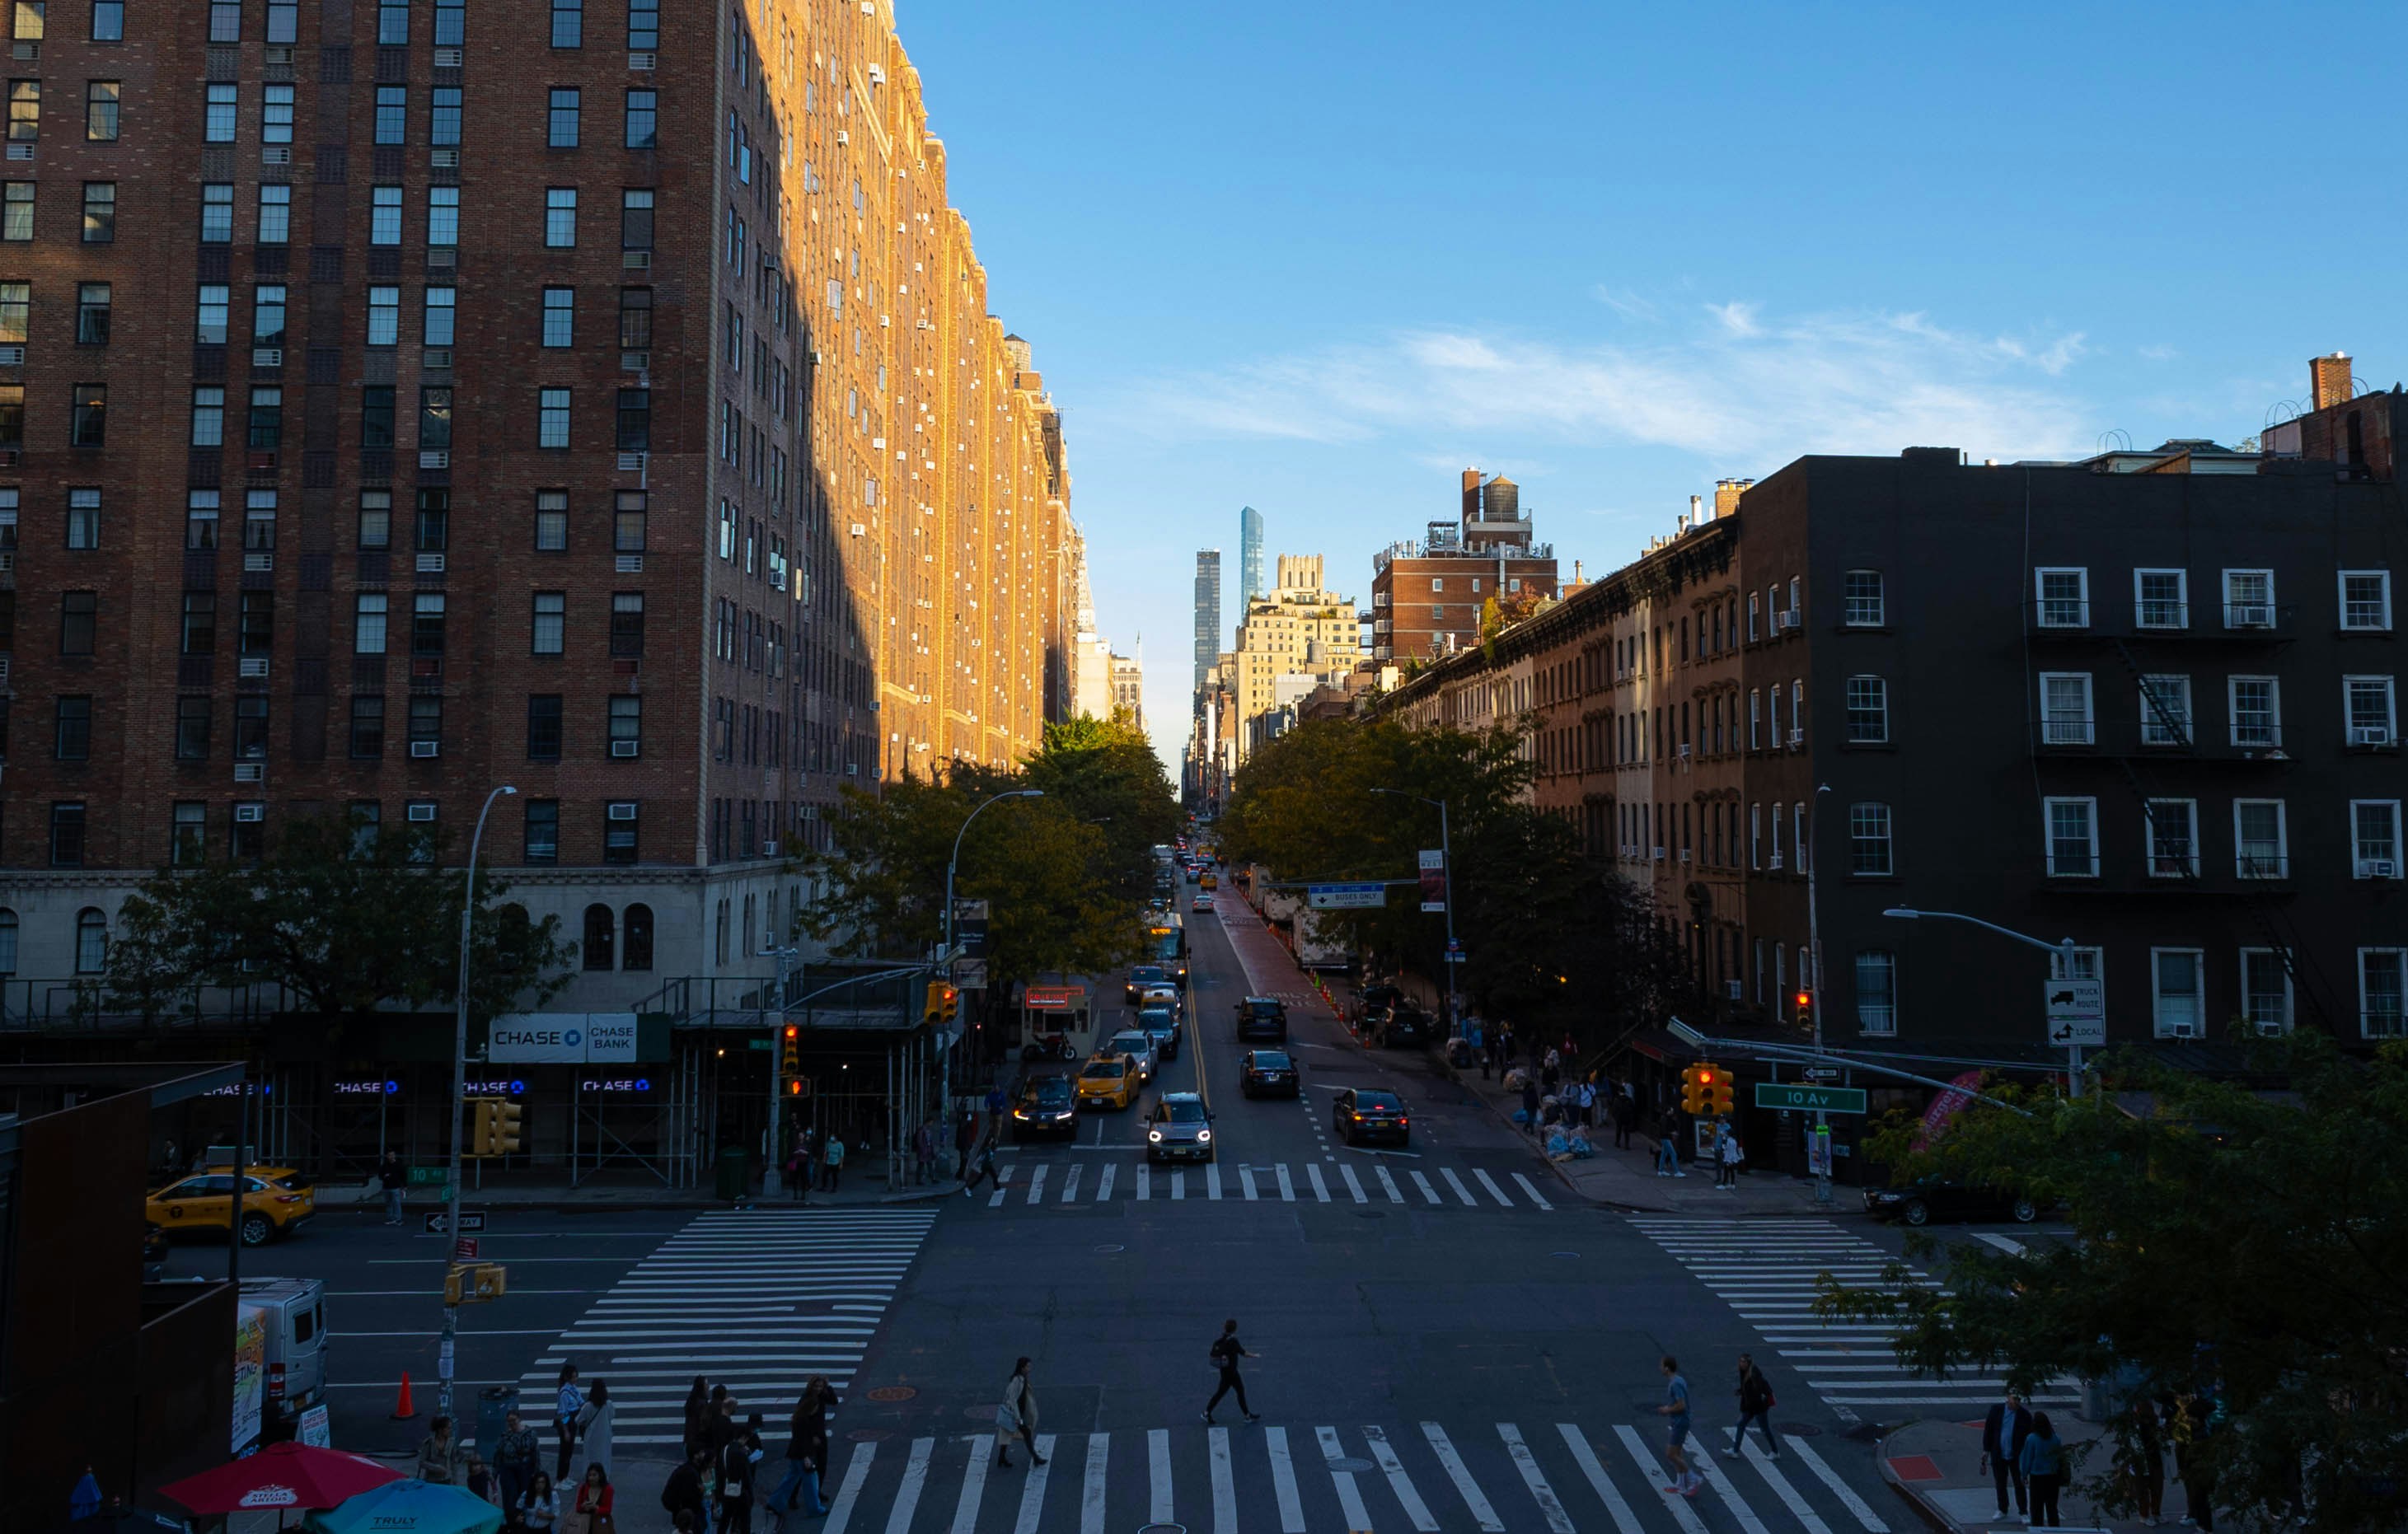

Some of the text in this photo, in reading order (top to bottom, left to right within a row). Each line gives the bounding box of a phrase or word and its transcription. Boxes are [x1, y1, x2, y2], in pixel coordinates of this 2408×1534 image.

[2076, 988, 2098, 996] TRUCK
[2076, 1000, 2099, 1008] ROUTE
[591, 1027, 634, 1036] CHASE
[495, 1031, 561, 1045] CHASE
[594, 1040, 630, 1049] BANK
[583, 1081, 634, 1092] CHASE
[1787, 1092, 1829, 1105] 10 Av
[413, 1169, 427, 1181] 10
[373, 1517, 419, 1525] TRULY
